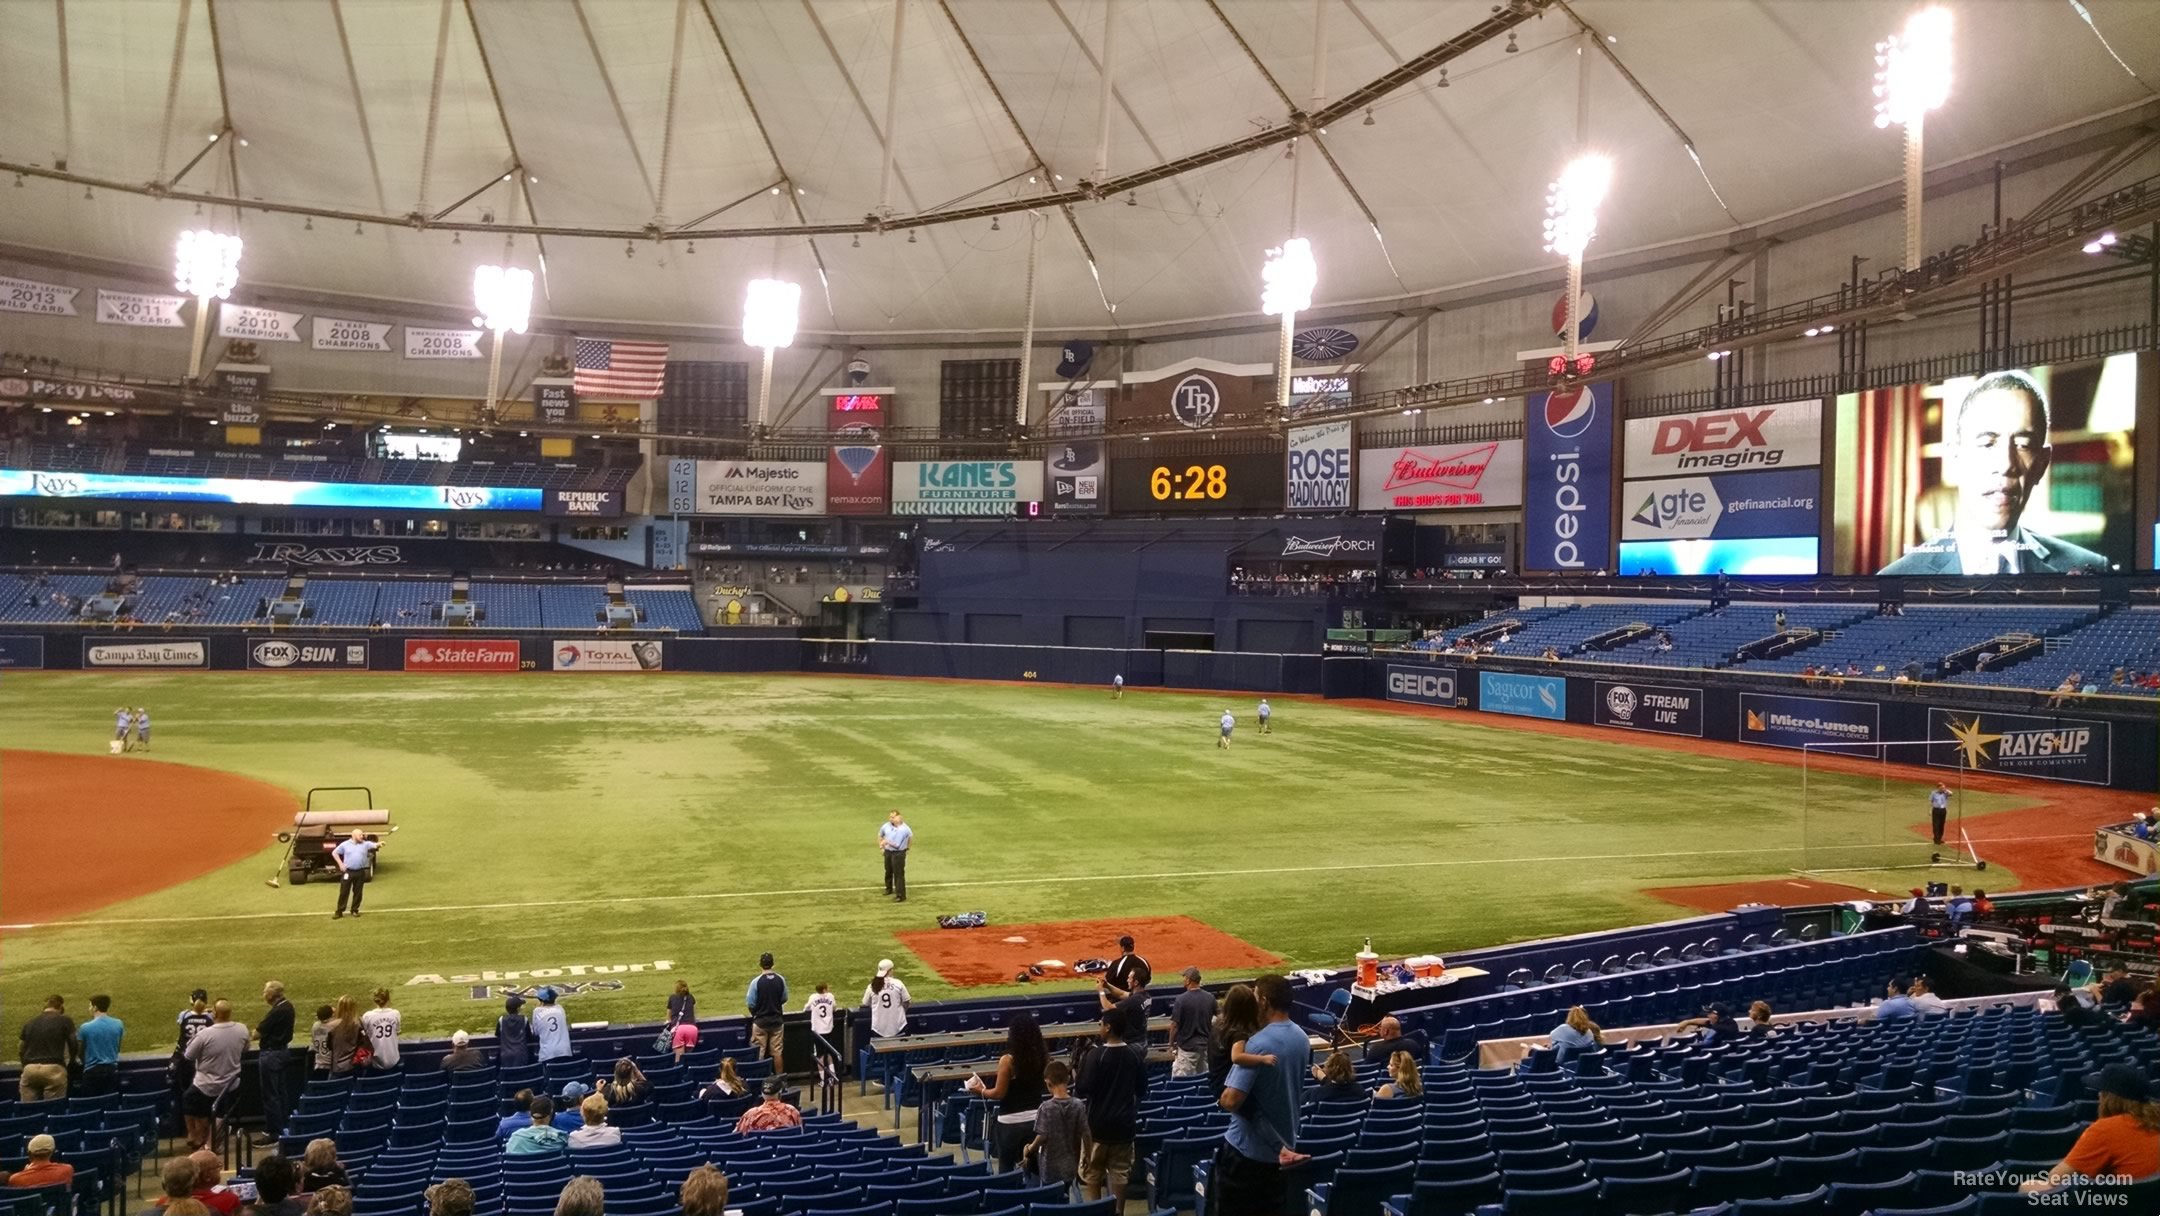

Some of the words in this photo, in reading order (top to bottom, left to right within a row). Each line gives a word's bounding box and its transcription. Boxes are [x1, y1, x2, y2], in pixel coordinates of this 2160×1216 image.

[11, 288, 56, 305] 2013
[40, 286, 74, 296] LEAGUE
[100, 294, 142, 303] AMERICAN
[144, 298, 179, 306] LEAGUE
[32, 303, 65, 314] CARD
[119, 302, 161, 317] 2011
[256, 310, 279, 318] EAST
[106, 312, 135, 322] WILD
[140, 315, 172, 325] CARD
[238, 316, 280, 330] 2010
[225, 325, 290, 340] CHAMPIONS
[330, 328, 371, 341] 2008
[318, 338, 381, 350] CHAMPIONS
[423, 337, 463, 349] 2008
[410, 347, 473, 357] CHAMPIONS
[543, 388, 566, 399] Fast
[541, 399, 570, 408] news
[1180, 385, 1212, 417] TB
[231, 403, 253, 414] the
[545, 408, 566, 417] you
[223, 411, 260, 424] buzz?
[1059, 416, 1096, 425] ON-FIELD
[1651, 409, 1776, 456] DEX
[1288, 448, 1350, 480] ROSE
[1677, 448, 1785, 469] imaging
[674, 462, 691, 475] 42
[746, 467, 800, 482] Majestic
[920, 462, 1017, 488] KANE'S
[1393, 459, 1485, 481] Budweiser
[676, 480, 689, 493] 12
[708, 484, 745, 493] OFFICIAL
[747, 484, 783, 493] UNIFORM
[785, 485, 796, 493] OF
[1078, 480, 1095, 488] NEW
[1151, 464, 1228, 501] 6:28
[558, 491, 610, 503] REPUBLIC
[830, 494, 883, 504] remax.com
[922, 490, 1011, 499] FURNITURE
[1288, 480, 1349, 507] RADIOLOGY
[568, 501, 600, 512] BANK
[673, 497, 691, 511] 66
[708, 495, 753, 506] TAMPA
[755, 495, 780, 506] BAY
[1394, 495, 1413, 507] THIS
[1444, 494, 1462, 506] FOR
[1661, 488, 1706, 521] gte
[1728, 496, 1814, 514] gtefinancial.org
[1551, 453, 1586, 567] pepsi
[1668, 513, 1711, 530] financial
[707, 544, 732, 552] Ballpark
[1289, 540, 1336, 552] Budweiser
[1336, 540, 1376, 551] PORCH
[1457, 556, 1478, 565] GRAB
[715, 585, 752, 598] Ducky's
[95, 649, 135, 663] Tampa
[137, 648, 161, 663] Bay
[163, 648, 199, 661] Times
[264, 646, 289, 657] FOX
[301, 646, 336, 663] SUN
[584, 650, 633, 660] TOTAL
[521, 660, 536, 669] 370
[1023, 671, 1037, 679] 404
[1389, 672, 1454, 699] GEICO
[1487, 675, 1535, 704] Sagicor
[1457, 696, 1468, 706] 370
[1613, 691, 1630, 705] FOX
[1643, 694, 1690, 710] STREAM
[1621, 708, 1631, 719] GO
[1654, 710, 1678, 724] LIVE
[1770, 713, 1870, 734] MicroLumen
[1785, 725, 1821, 736] PERFORMANCE
[1822, 730, 1846, 738] MEDICAL
[1846, 732, 1870, 740] DEVICES
[2000, 732, 2052, 756] RAYS
[2058, 730, 2090, 754] UP
[2037, 757, 2088, 766] COMMUNITY
[403, 959, 676, 986] AstroTurf
[881, 992, 892, 1009] 9
[820, 1005, 828, 1018] 3
[547, 1016, 558, 1032] 3
[375, 1024, 393, 1039] 39
